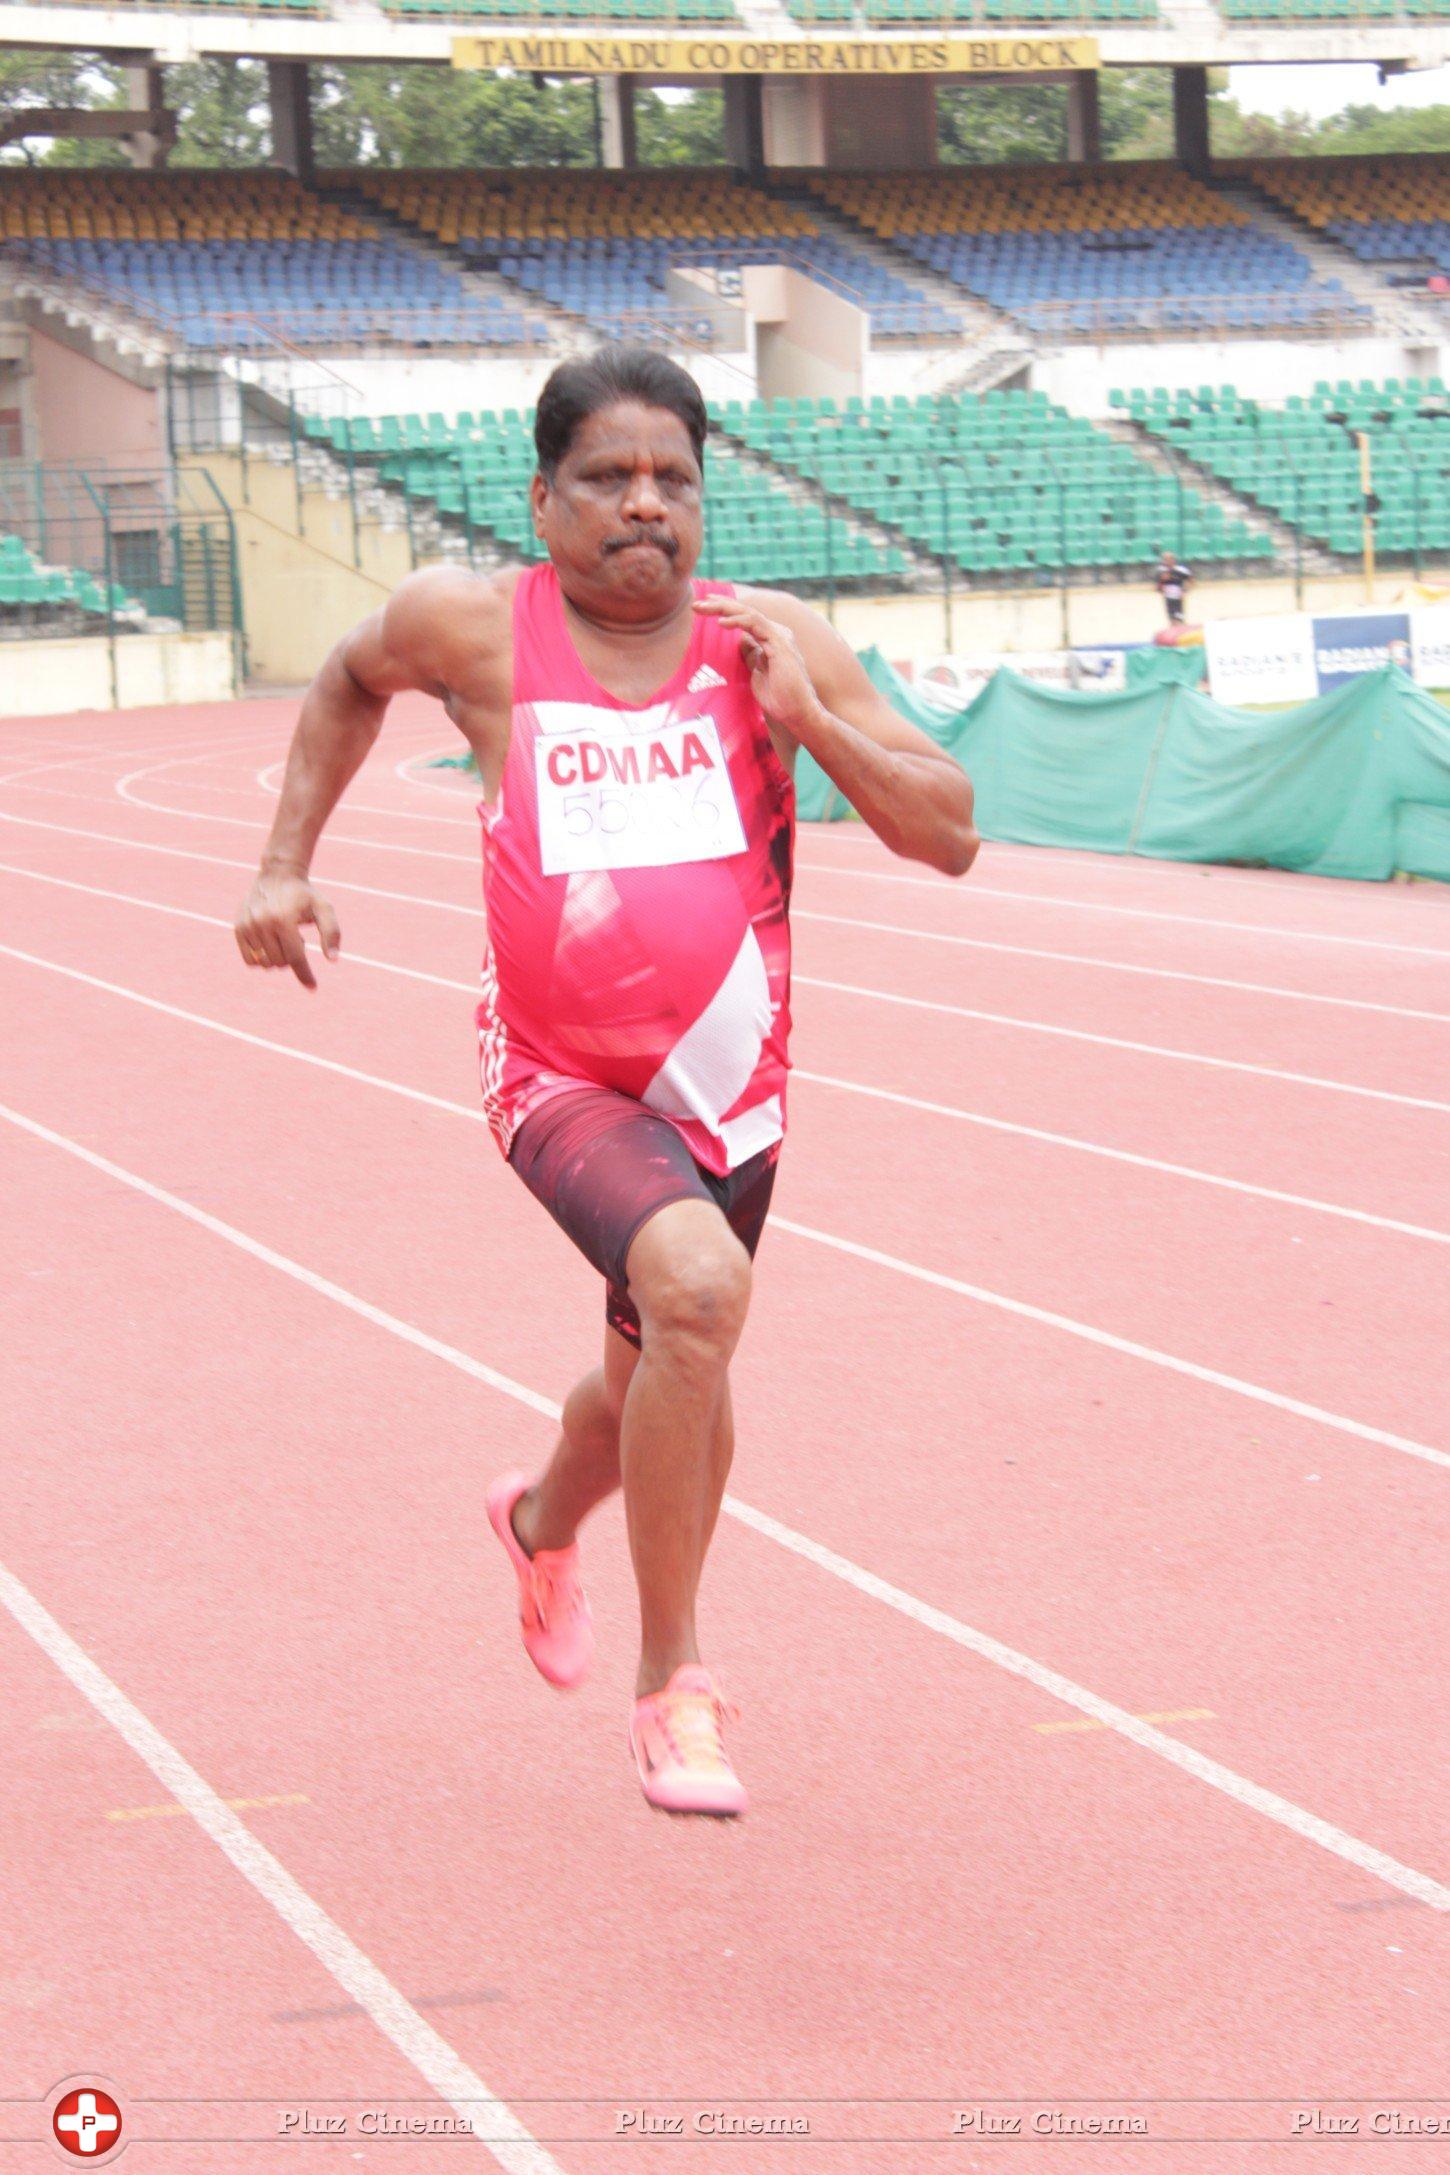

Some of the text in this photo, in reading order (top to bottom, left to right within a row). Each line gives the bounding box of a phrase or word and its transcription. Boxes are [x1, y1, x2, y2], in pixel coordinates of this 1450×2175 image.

[475, 40, 671, 68] TAMILNADU
[969, 41, 1079, 67] BLOCK
[547, 732, 715, 786] CDMAA
